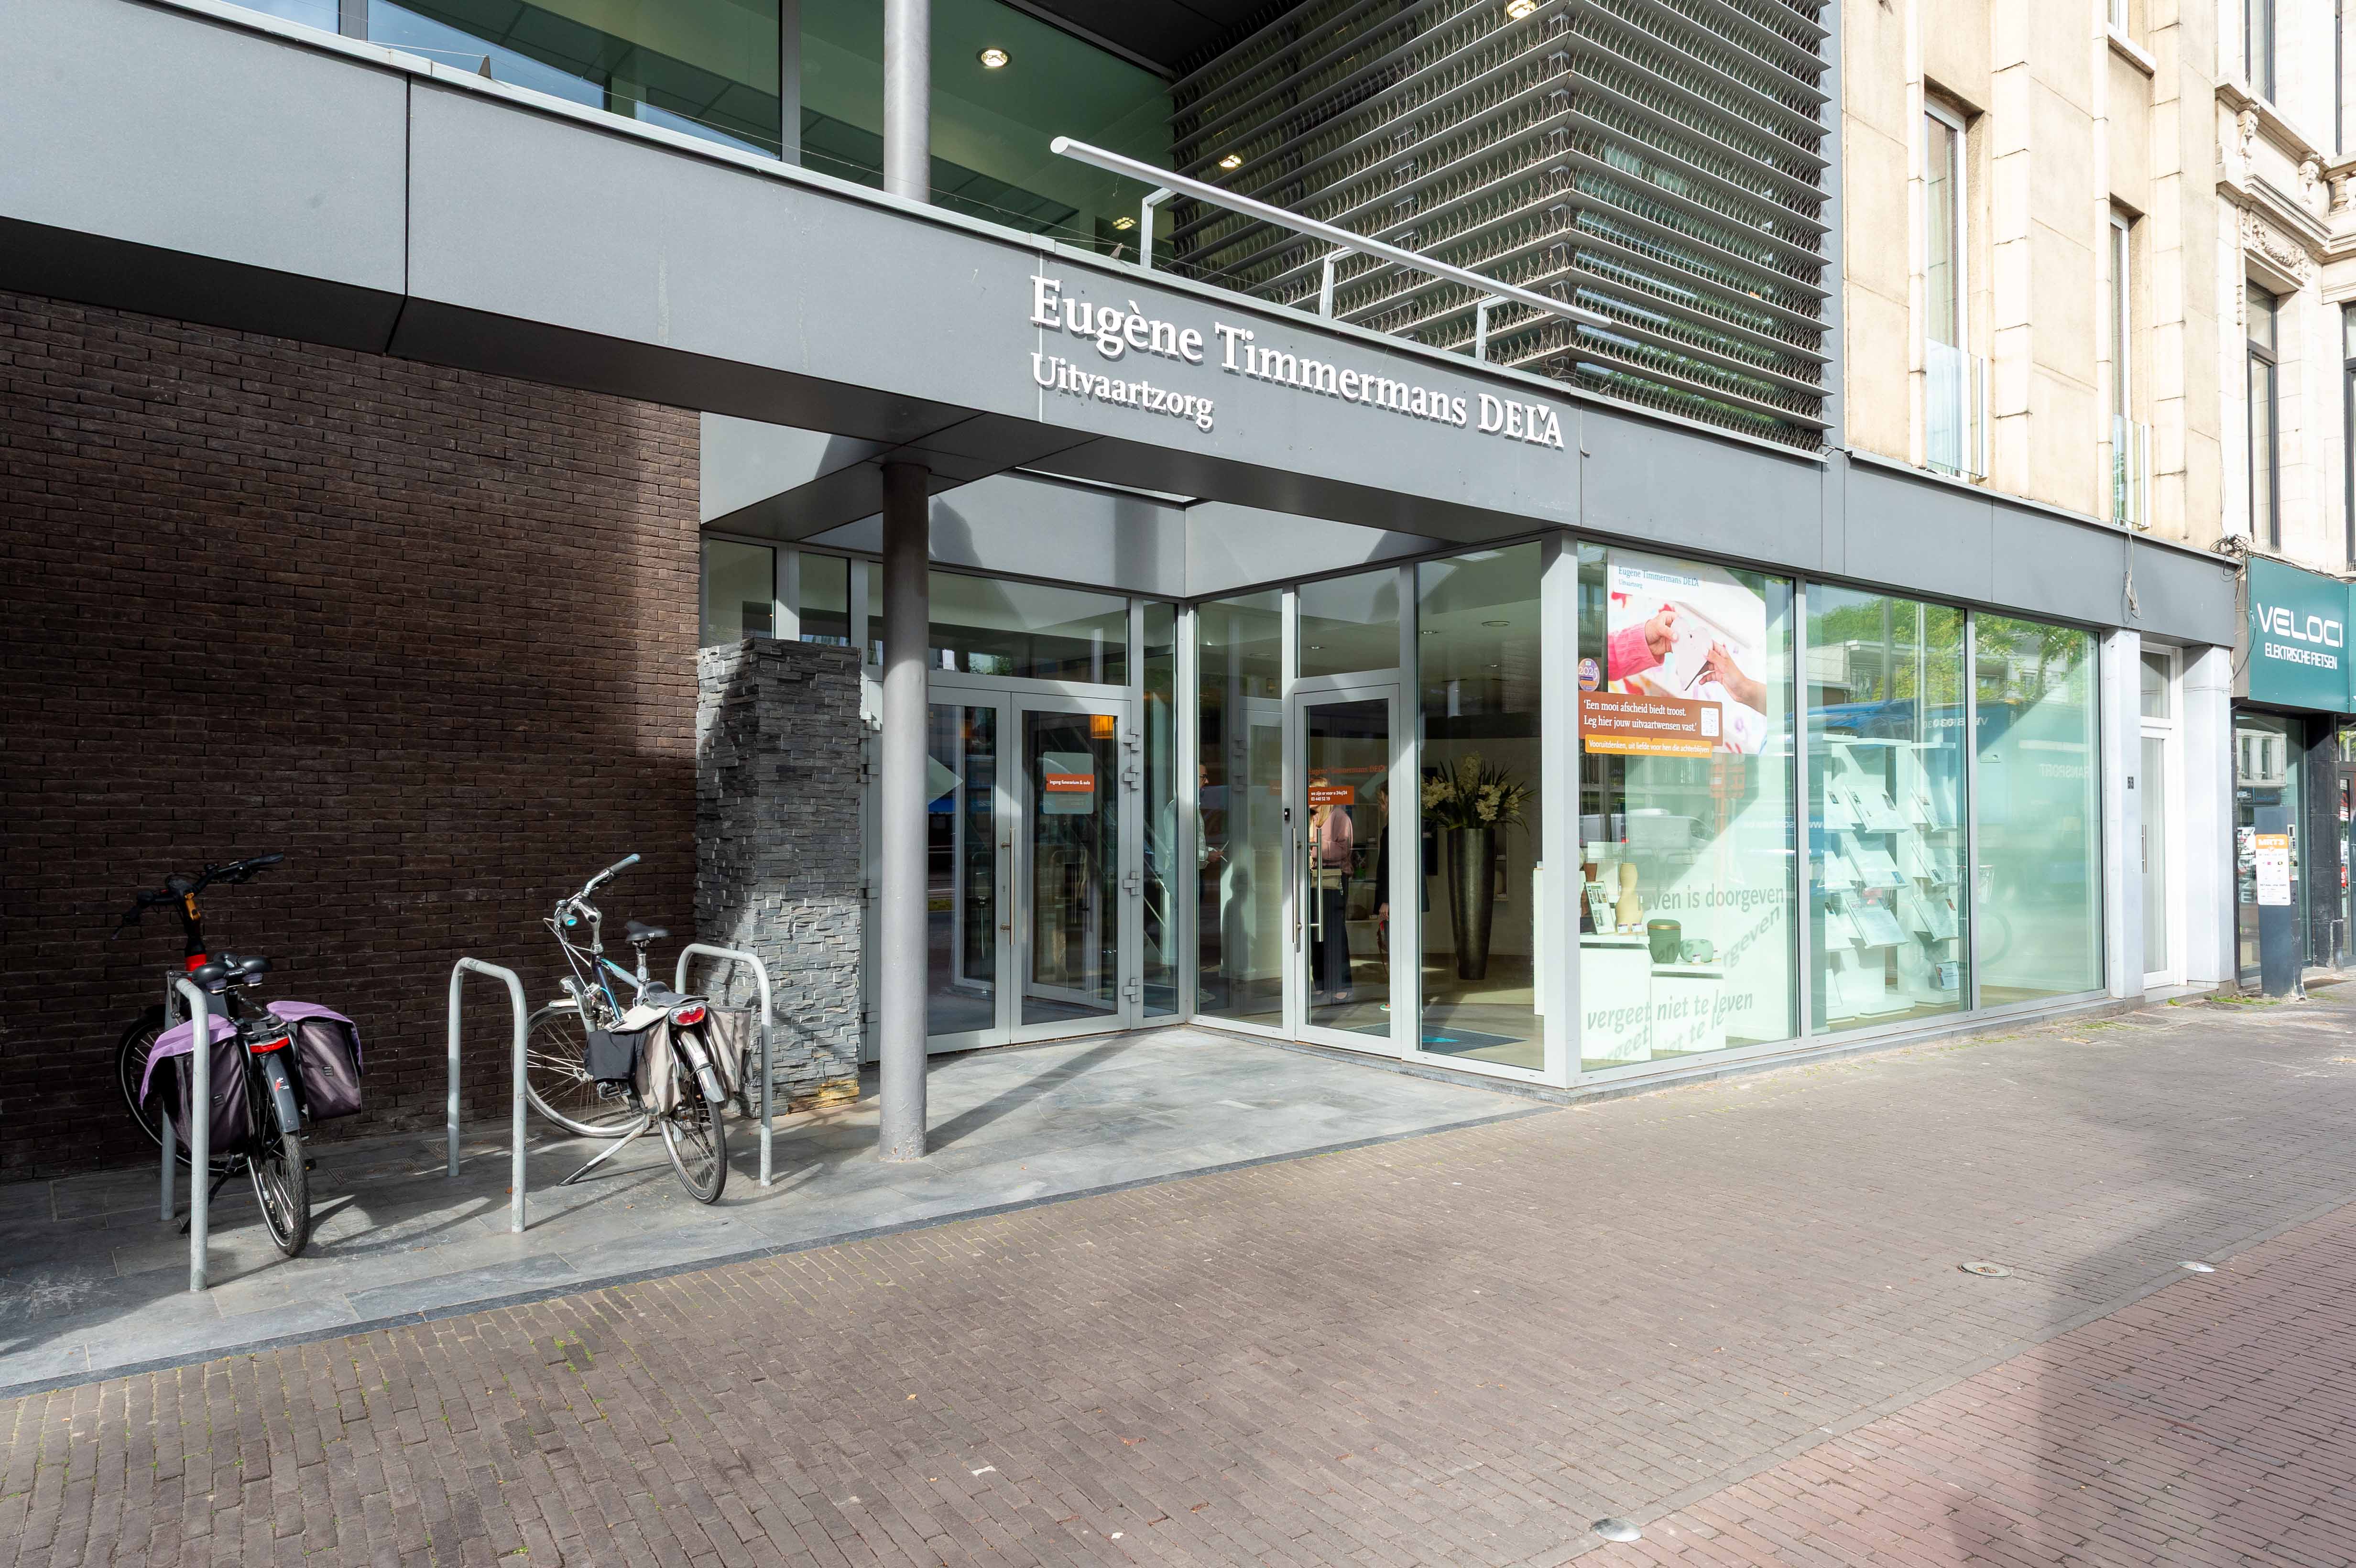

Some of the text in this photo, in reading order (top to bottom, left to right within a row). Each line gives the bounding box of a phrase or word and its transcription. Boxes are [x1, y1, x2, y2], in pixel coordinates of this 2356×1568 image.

[1030, 275, 1564, 447] Eugène Timmermans DELA
[1030, 352, 1213, 428] Uitvaartzorg
[1642, 569, 1681, 584] Timmermans
[2257, 603, 2343, 648] VELOCI
[2265, 642, 2337, 669] ELEKTRISCHE FIETSEN
[1579, 666, 1599, 680] 2025
[1584, 715, 1597, 728] Leg
[1598, 715, 1613, 726] hier
[1614, 717, 1630, 729] jouw
[1632, 719, 1680, 730] uitvaartwensen
[1601, 702, 1619, 711] mooi
[1620, 702, 1647, 713] afscheid
[1649, 704, 1665, 715] biedt
[1667, 707, 1686, 716] troost.
[1589, 740, 1627, 750] Vooruitdenken,
[1688, 884, 1700, 908] is
[1706, 883, 1784, 912] doorgeven
[1587, 1002, 1651, 1034] vergeet
[1657, 995, 1689, 1021] niet
[1694, 995, 1709, 1016] te
[1713, 989, 1753, 1013] leven
